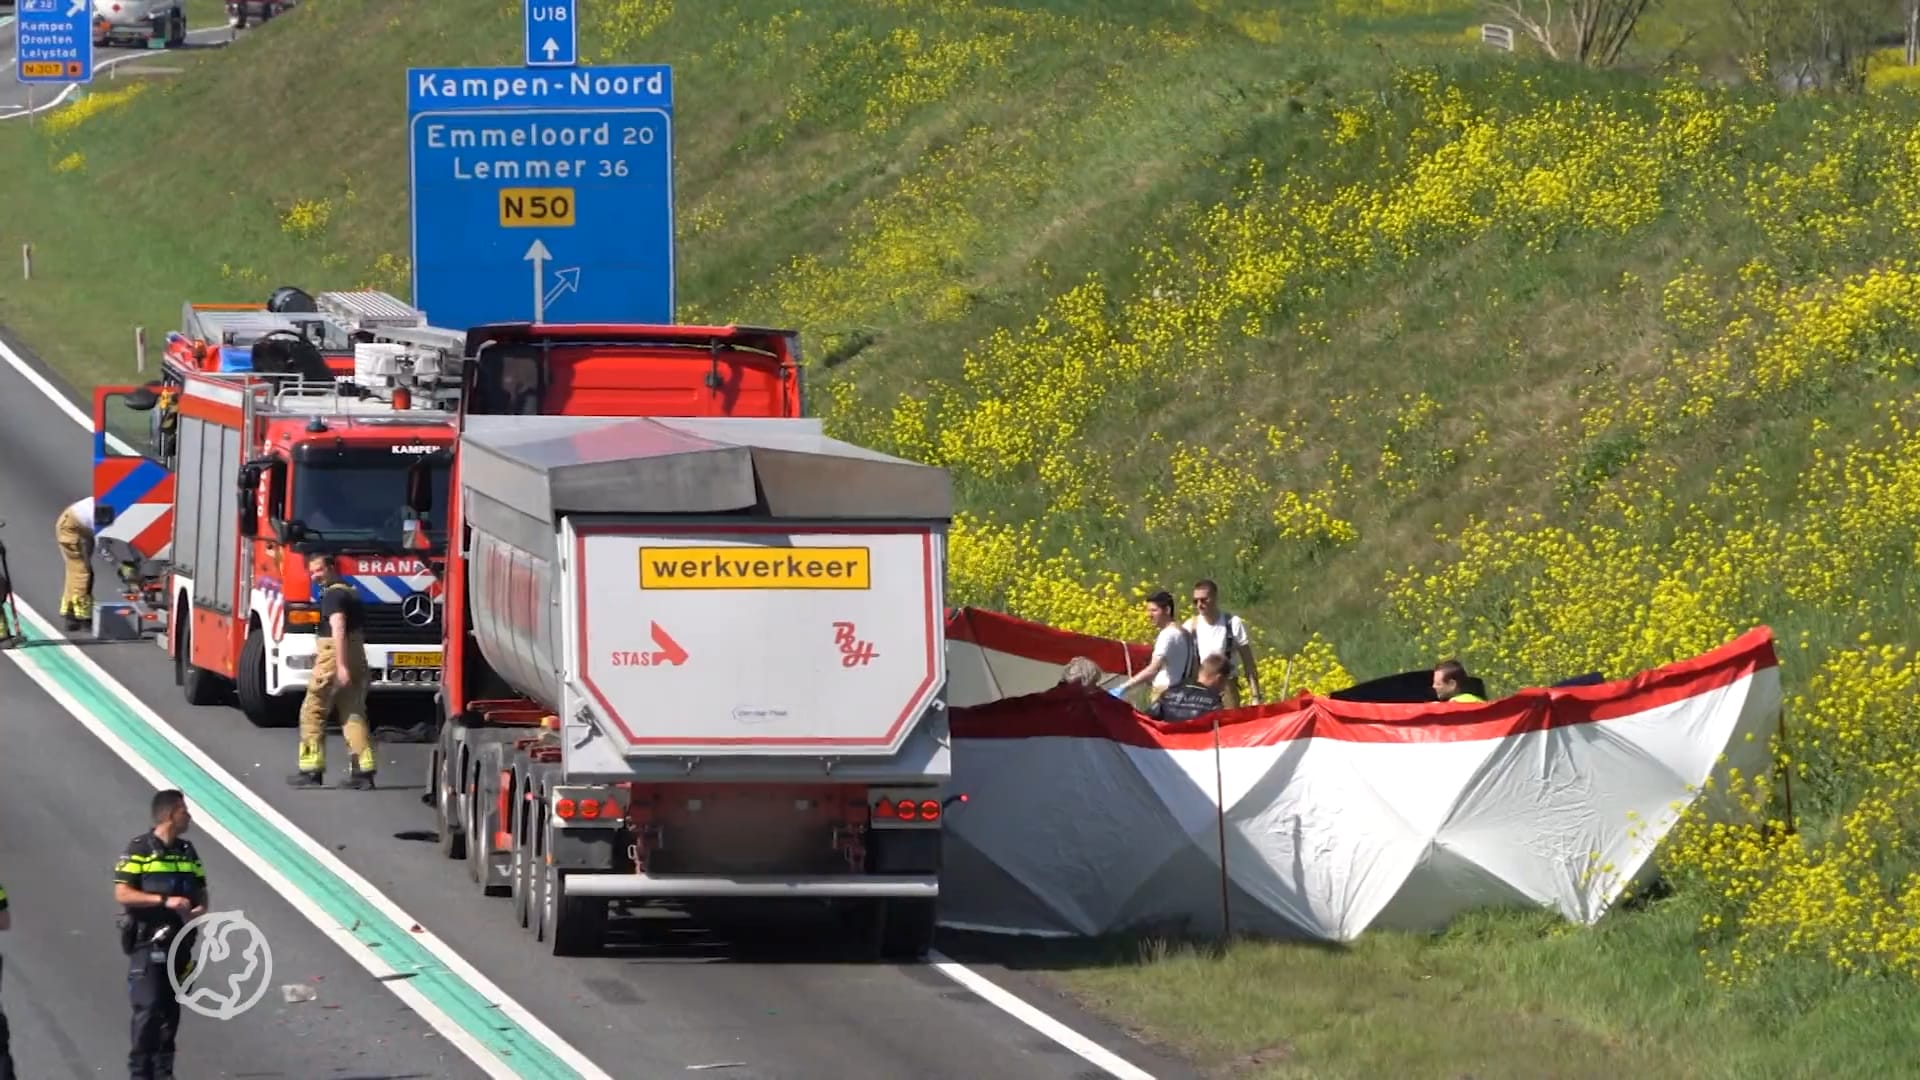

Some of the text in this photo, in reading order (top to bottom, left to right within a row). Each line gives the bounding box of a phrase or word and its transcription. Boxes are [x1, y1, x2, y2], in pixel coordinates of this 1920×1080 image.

[533, 7, 567, 21] U18
[21, 22, 73, 32] Kampen
[21, 35, 73, 45] Dronten
[21, 48, 77, 60] Lelystad
[418, 71, 664, 100] Kampen-Noord
[427, 122, 654, 149] Emmeloord 20
[454, 156, 629, 180] Lemmer 36
[504, 196, 569, 219] N50
[653, 554, 858, 579] werkverkeer
[611, 651, 650, 667] STAS
